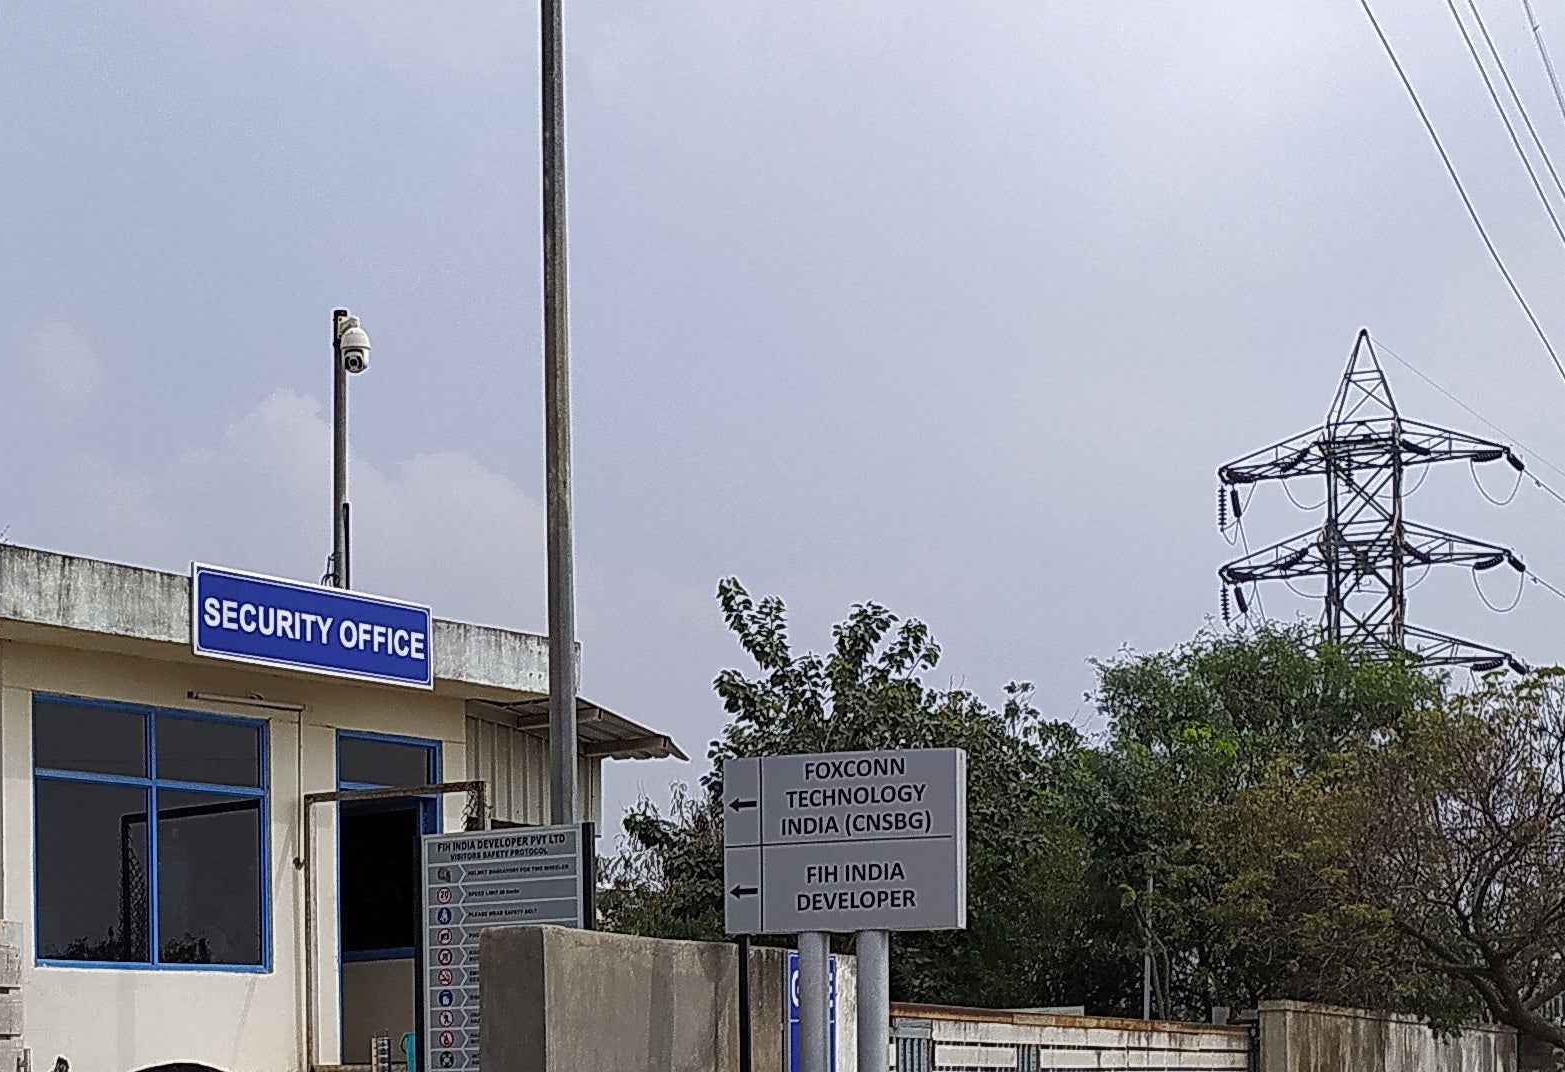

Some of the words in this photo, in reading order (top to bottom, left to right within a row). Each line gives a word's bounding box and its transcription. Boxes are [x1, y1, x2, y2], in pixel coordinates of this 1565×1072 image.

[203, 596, 334, 645] SECURITY
[339, 619, 425, 660] OFFICE
[804, 757, 906, 781] FOXCONN
[785, 783, 926, 809] TECHNOLOGY
[781, 816, 839, 836] INDIA
[845, 809, 932, 837] (CNSBG)
[437, 842, 451, 853] FIH
[452, 840, 476, 852] INDIA
[477, 835, 529, 850] DEVELOPER
[530, 834, 547, 846] PVT
[548, 833, 566, 845] LTD
[450, 851, 481, 861] VISITORS
[482, 849, 509, 859] SAFETY
[510, 847, 548, 858] PROTOCOL
[806, 864, 838, 884] FIH
[845, 862, 905, 882] INDIA
[440, 890, 449, 899] 20
[796, 889, 916, 912] DEVELOPER
